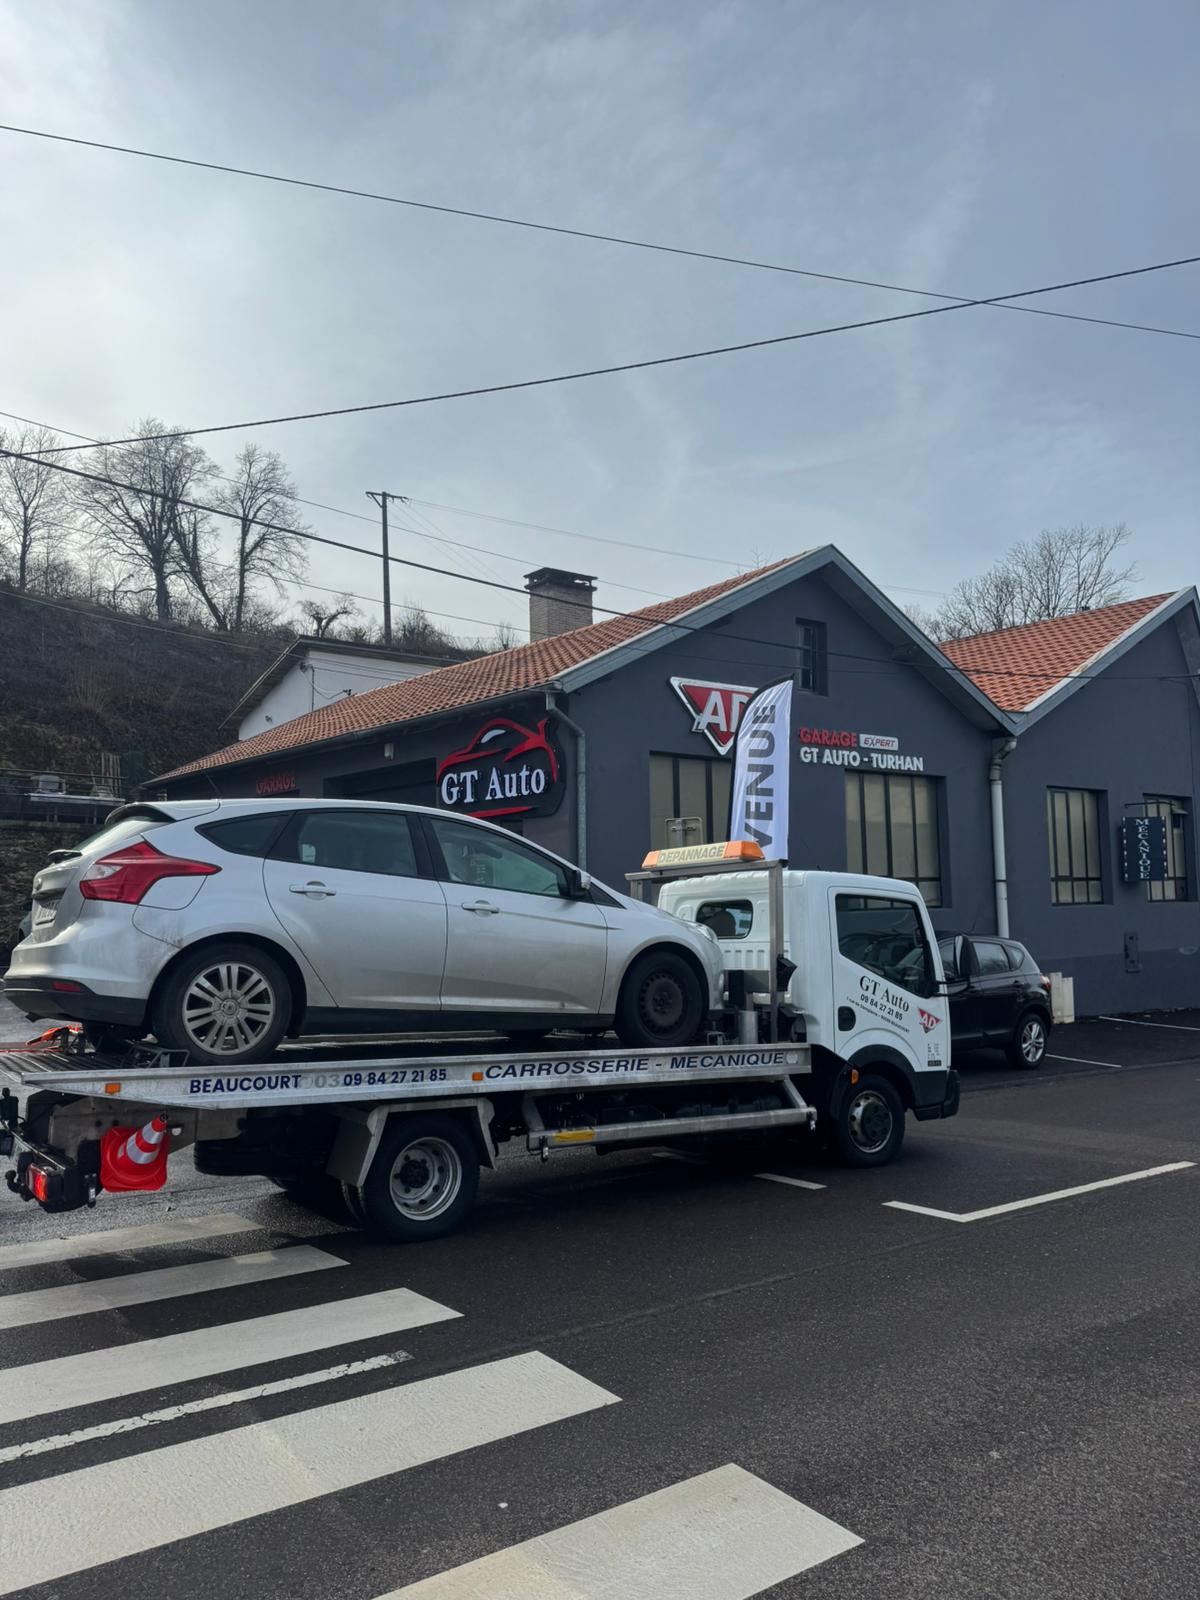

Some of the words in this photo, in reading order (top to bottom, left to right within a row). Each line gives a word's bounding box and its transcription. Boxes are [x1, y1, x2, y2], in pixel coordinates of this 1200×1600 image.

[799, 727, 857, 748] GARAGE
[863, 736, 896, 748] EXPERT
[800, 746, 819, 763] GT
[822, 748, 860, 767] AUTO
[870, 752, 924, 771] TURHAN
[441, 770, 478, 805] GT
[485, 764, 545, 801] Auto
[659, 845, 725, 864] DEPANNAGE
[1135, 818, 1151, 880] MECANIQUE
[860, 975, 881, 996] GT
[881, 987, 909, 1013] Auto
[860, 993, 869, 1004] 09
[869, 998, 878, 1009] 84
[879, 1003, 887, 1013] 27
[887, 1007, 894, 1016] 21
[894, 1011, 903, 1021] 85
[920, 1012, 937, 1030] AD
[484, 1057, 650, 1080] CARROSSERIE
[669, 1051, 785, 1070] MECANIQUE
[189, 1074, 302, 1094] BEAUCOURT
[343, 1072, 362, 1087] 09
[367, 1071, 387, 1085] 84
[389, 1070, 408, 1084] 27
[411, 1069, 425, 1083] 21
[429, 1068, 447, 1082] 85
